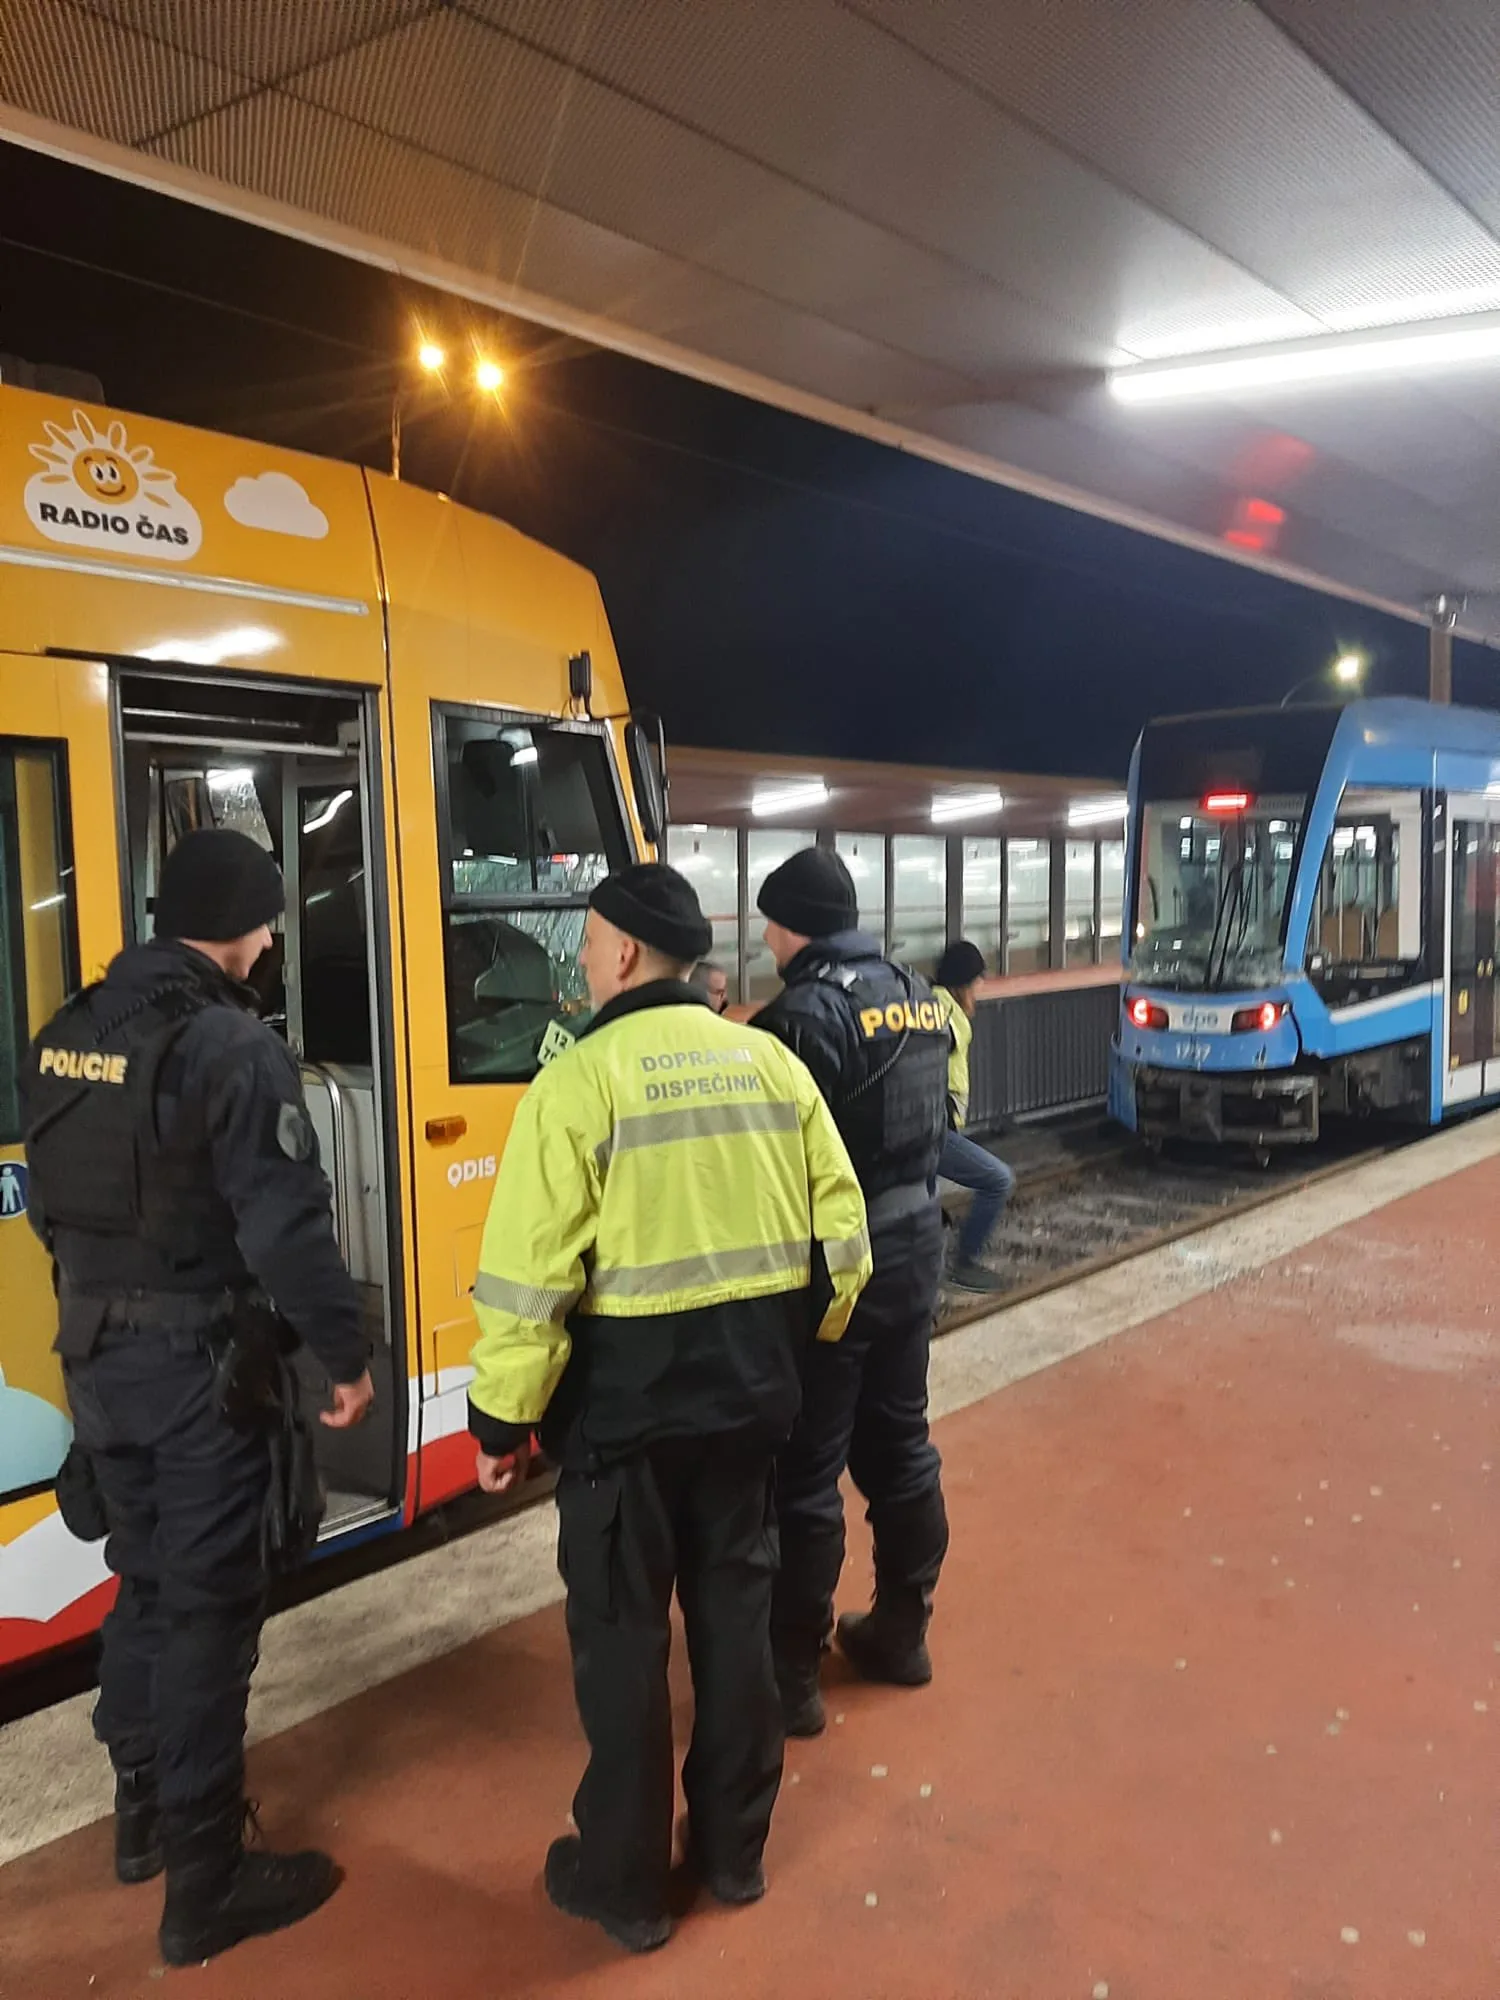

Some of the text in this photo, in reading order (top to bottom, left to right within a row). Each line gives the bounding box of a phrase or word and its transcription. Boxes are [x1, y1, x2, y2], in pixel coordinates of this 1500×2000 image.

[39, 502, 189, 545] RADIO ČAS
[860, 1000, 945, 1037] POLICI
[554, 1031, 568, 1050] 12
[40, 1048, 128, 1084] POLICIE
[645, 1072, 761, 1102] DISPEČINK
